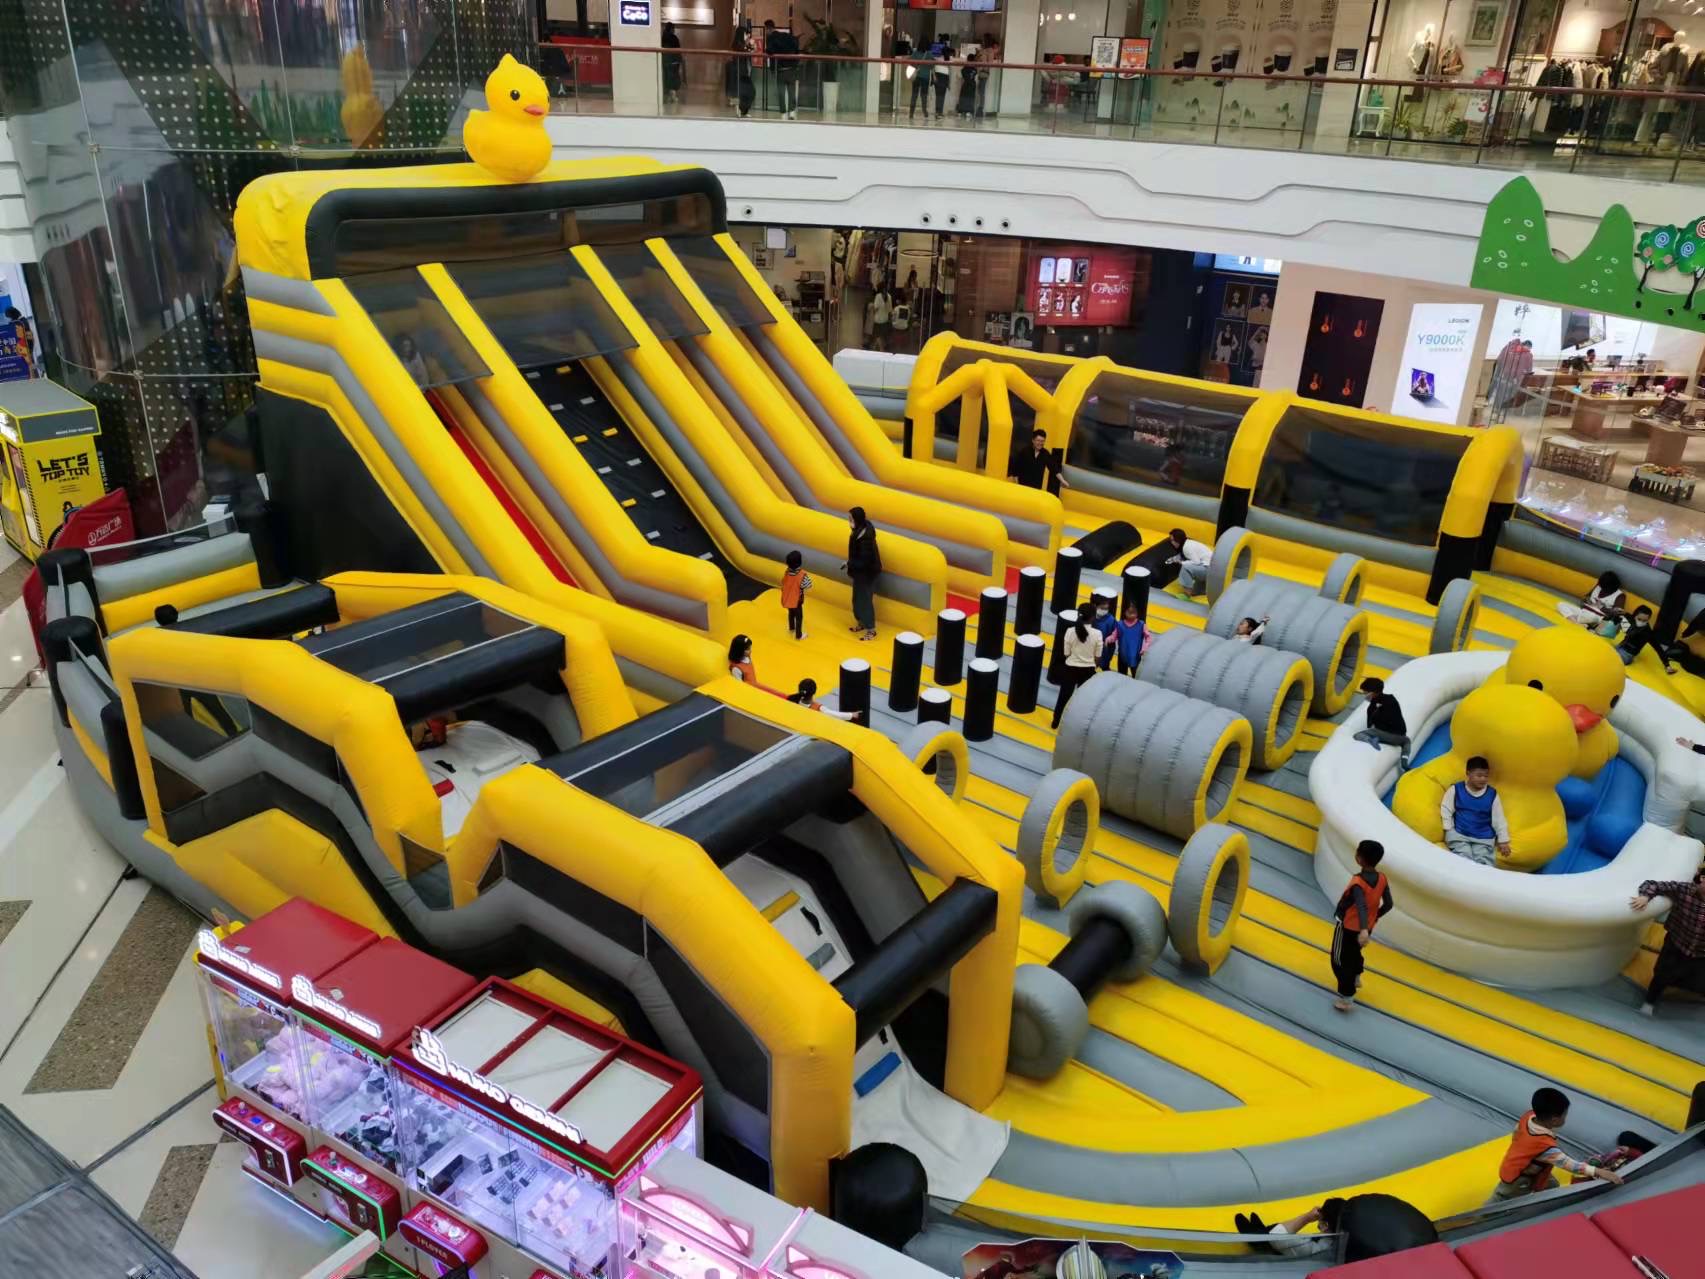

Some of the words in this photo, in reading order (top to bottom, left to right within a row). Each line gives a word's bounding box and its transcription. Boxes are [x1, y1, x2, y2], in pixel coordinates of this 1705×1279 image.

[1417, 334, 1465, 345] Y9000K
[36, 452, 89, 473] LET'S
[40, 470, 66, 483] TOP
[66, 467, 90, 477] TOY
